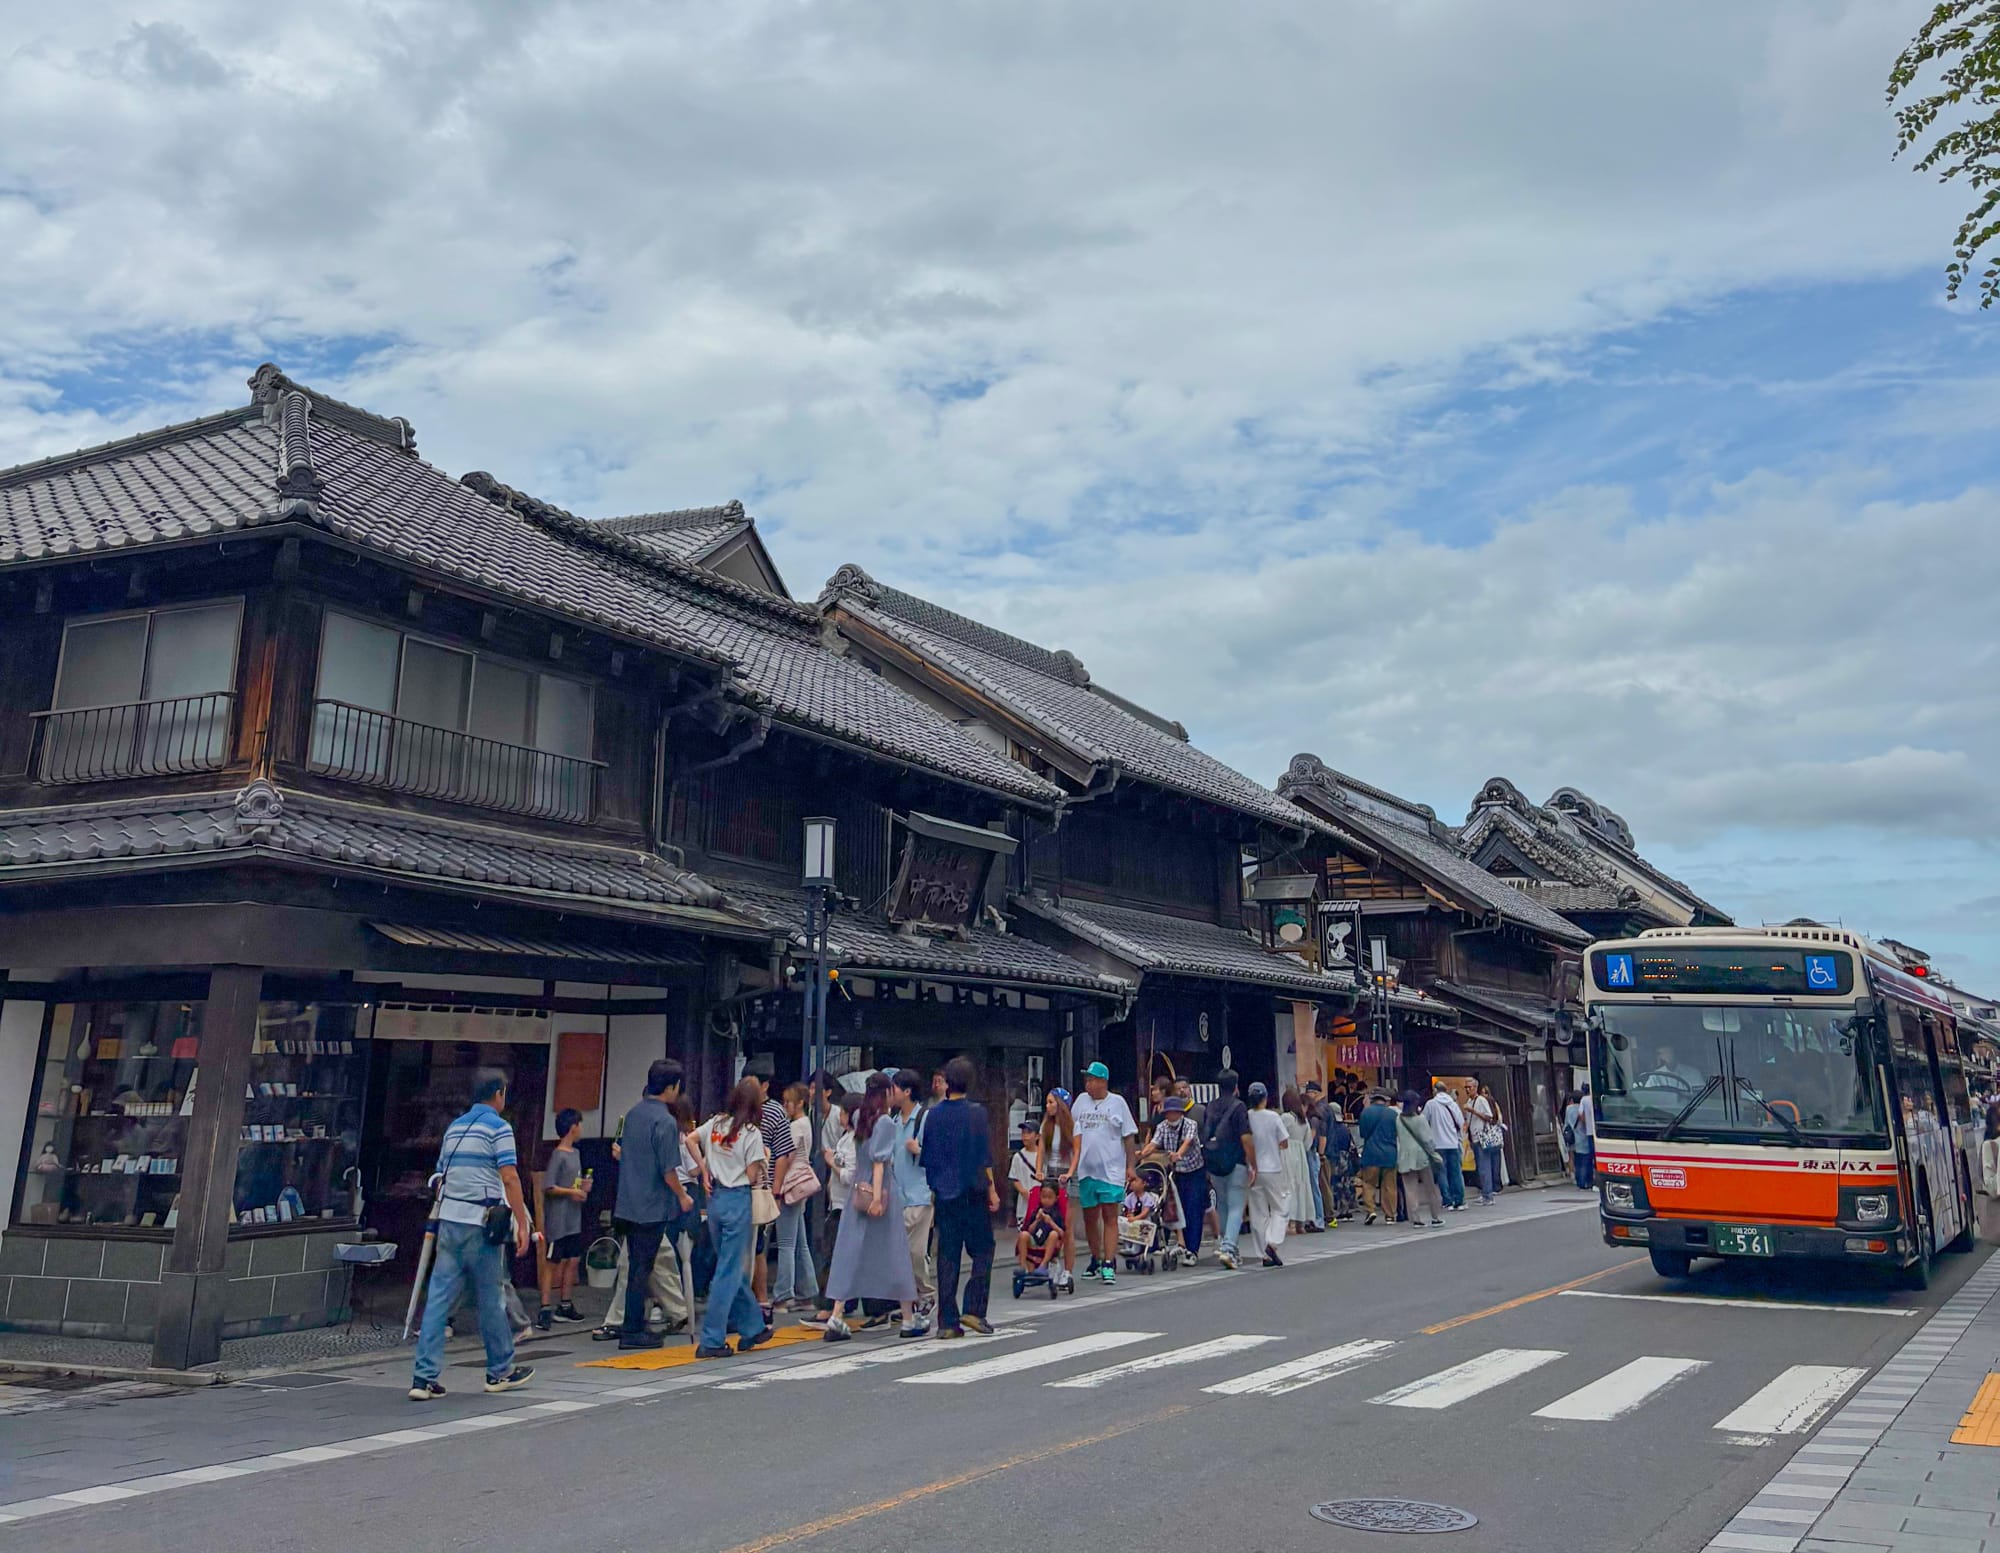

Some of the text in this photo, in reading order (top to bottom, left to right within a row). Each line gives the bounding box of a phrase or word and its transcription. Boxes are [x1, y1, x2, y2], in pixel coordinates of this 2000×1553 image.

[1607, 1163, 1635, 1174] 5224
[1803, 1159, 1873, 1172] 東武バス
